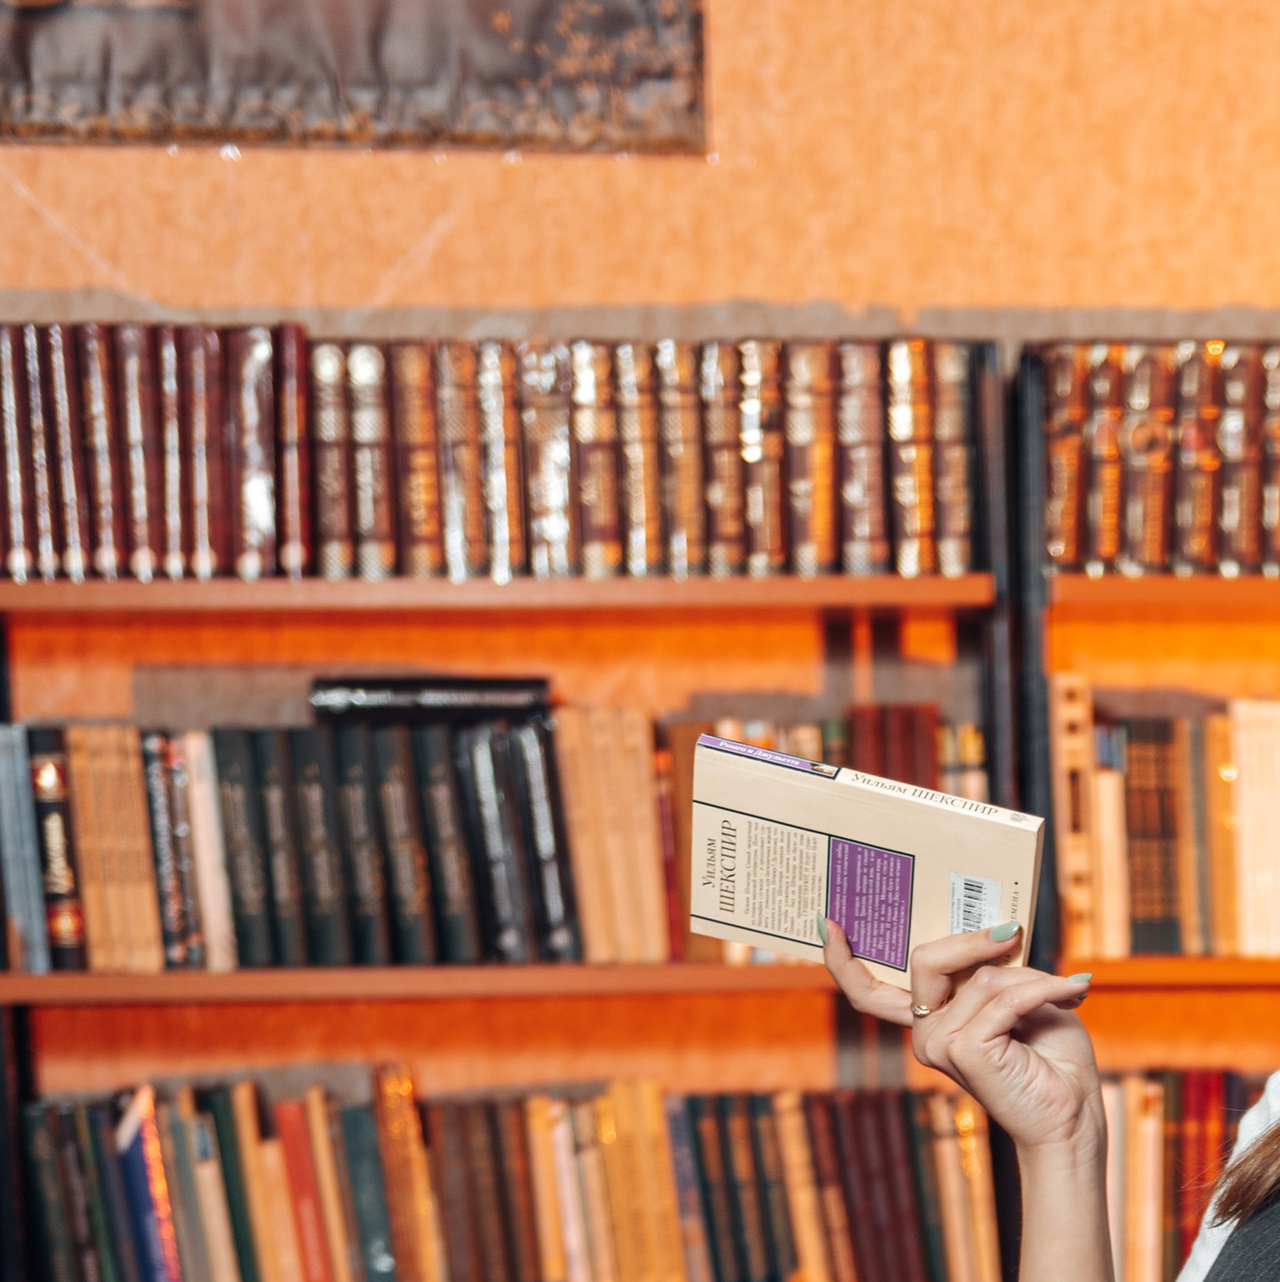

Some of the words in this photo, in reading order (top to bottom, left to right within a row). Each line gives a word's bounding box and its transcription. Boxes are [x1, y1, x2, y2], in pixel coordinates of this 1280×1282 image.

[719, 742, 746, 753] Ромео
[911, 788, 999, 815] ШЕКСПИР
[719, 819, 737, 914] ШЕКСПИР
[1010, 891, 1019, 922] ЕМЕНА
